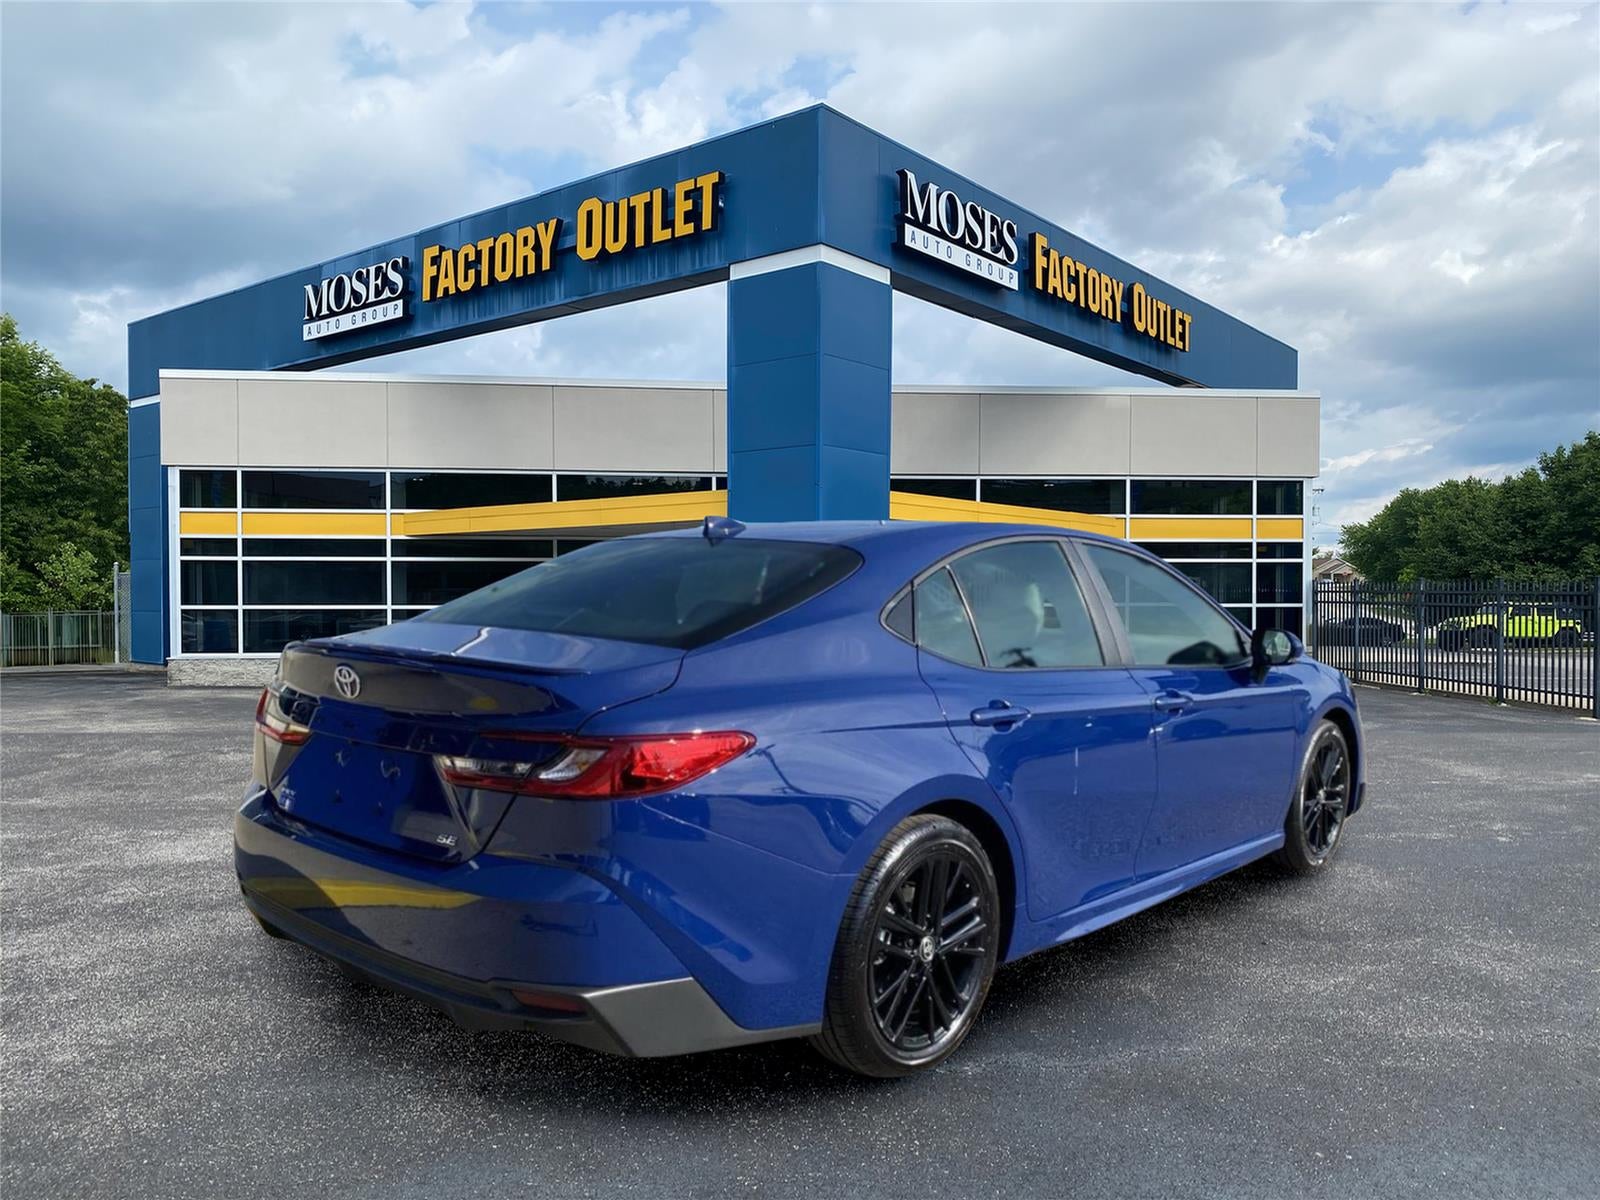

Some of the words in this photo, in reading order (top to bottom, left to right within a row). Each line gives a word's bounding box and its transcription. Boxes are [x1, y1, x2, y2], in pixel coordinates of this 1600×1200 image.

[422, 218, 558, 302] FACTORY
[576, 171, 720, 261] OUTLET
[903, 168, 1019, 265] MOSES
[303, 256, 405, 320] MOSES
[910, 230, 953, 259] AUTO
[965, 253, 1016, 284] GROUP
[307, 315, 341, 337] AUTO
[351, 303, 400, 326] GROUP
[1035, 232, 1124, 323] FACTORY
[1132, 283, 1192, 352] OUTLET
[436, 834, 457, 846] SE
